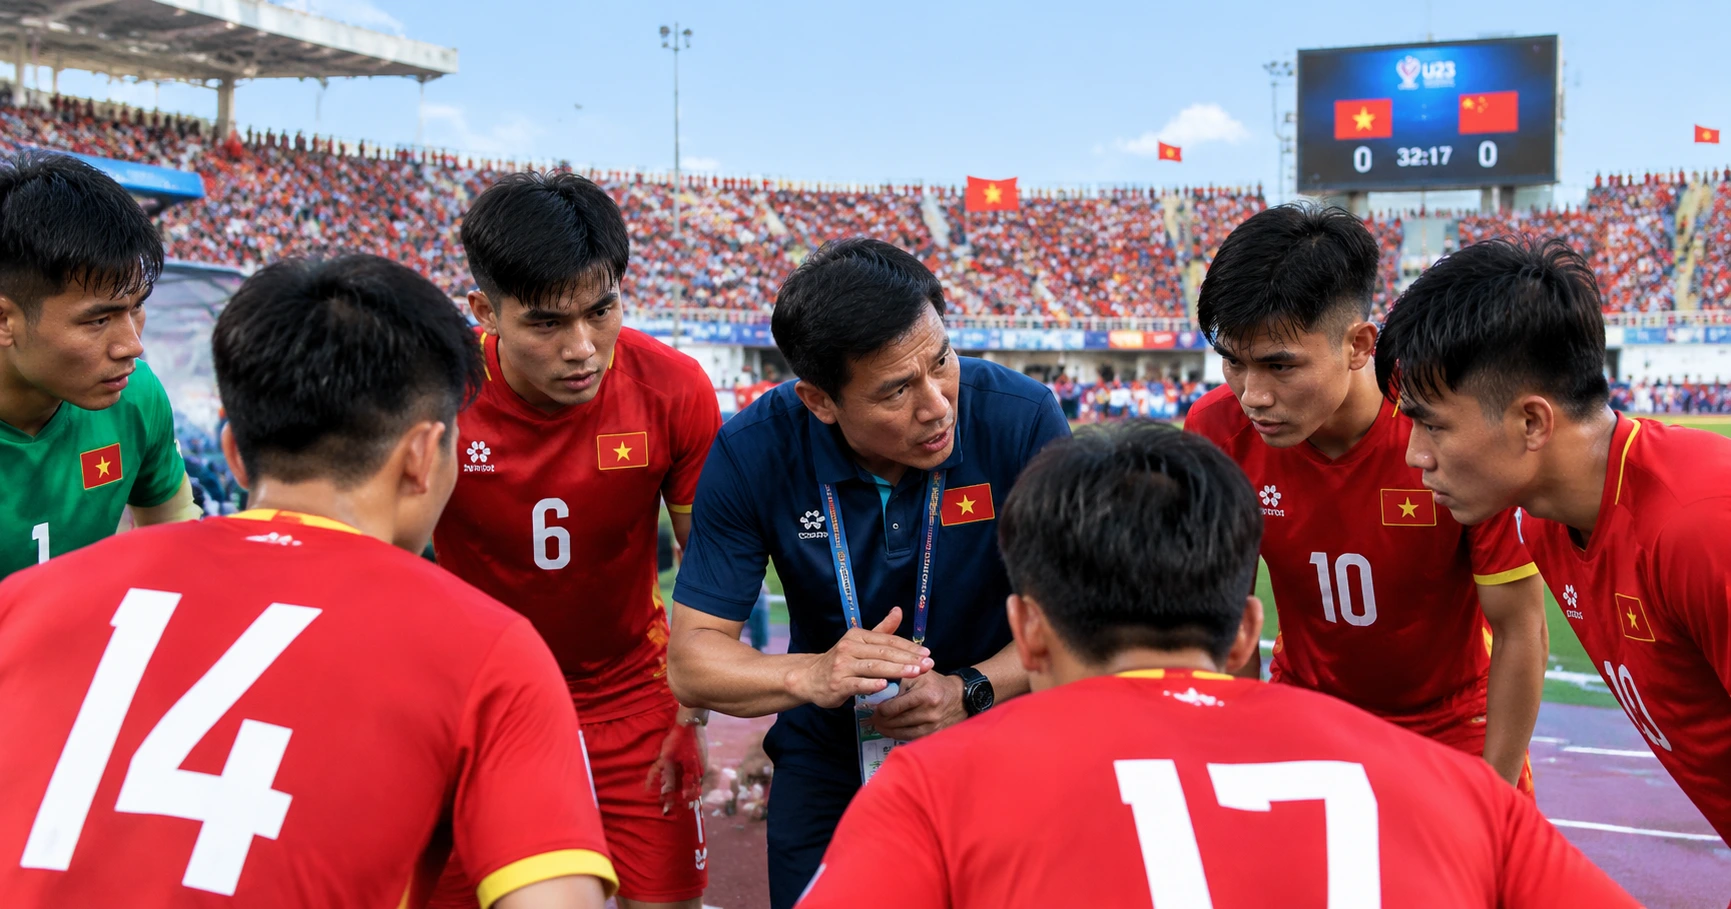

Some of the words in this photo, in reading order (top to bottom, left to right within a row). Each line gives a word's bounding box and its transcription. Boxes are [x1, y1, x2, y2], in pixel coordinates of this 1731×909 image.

[1422, 61, 1456, 80] U23
[1353, 146, 1373, 173] 0
[1396, 145, 1453, 167] 32:17
[1478, 140, 1498, 168] 0
[32, 522, 50, 565] 1
[532, 497, 571, 570] 6
[1309, 551, 1377, 627] 10
[20, 587, 323, 896] 14
[1113, 759, 1382, 909] 17
